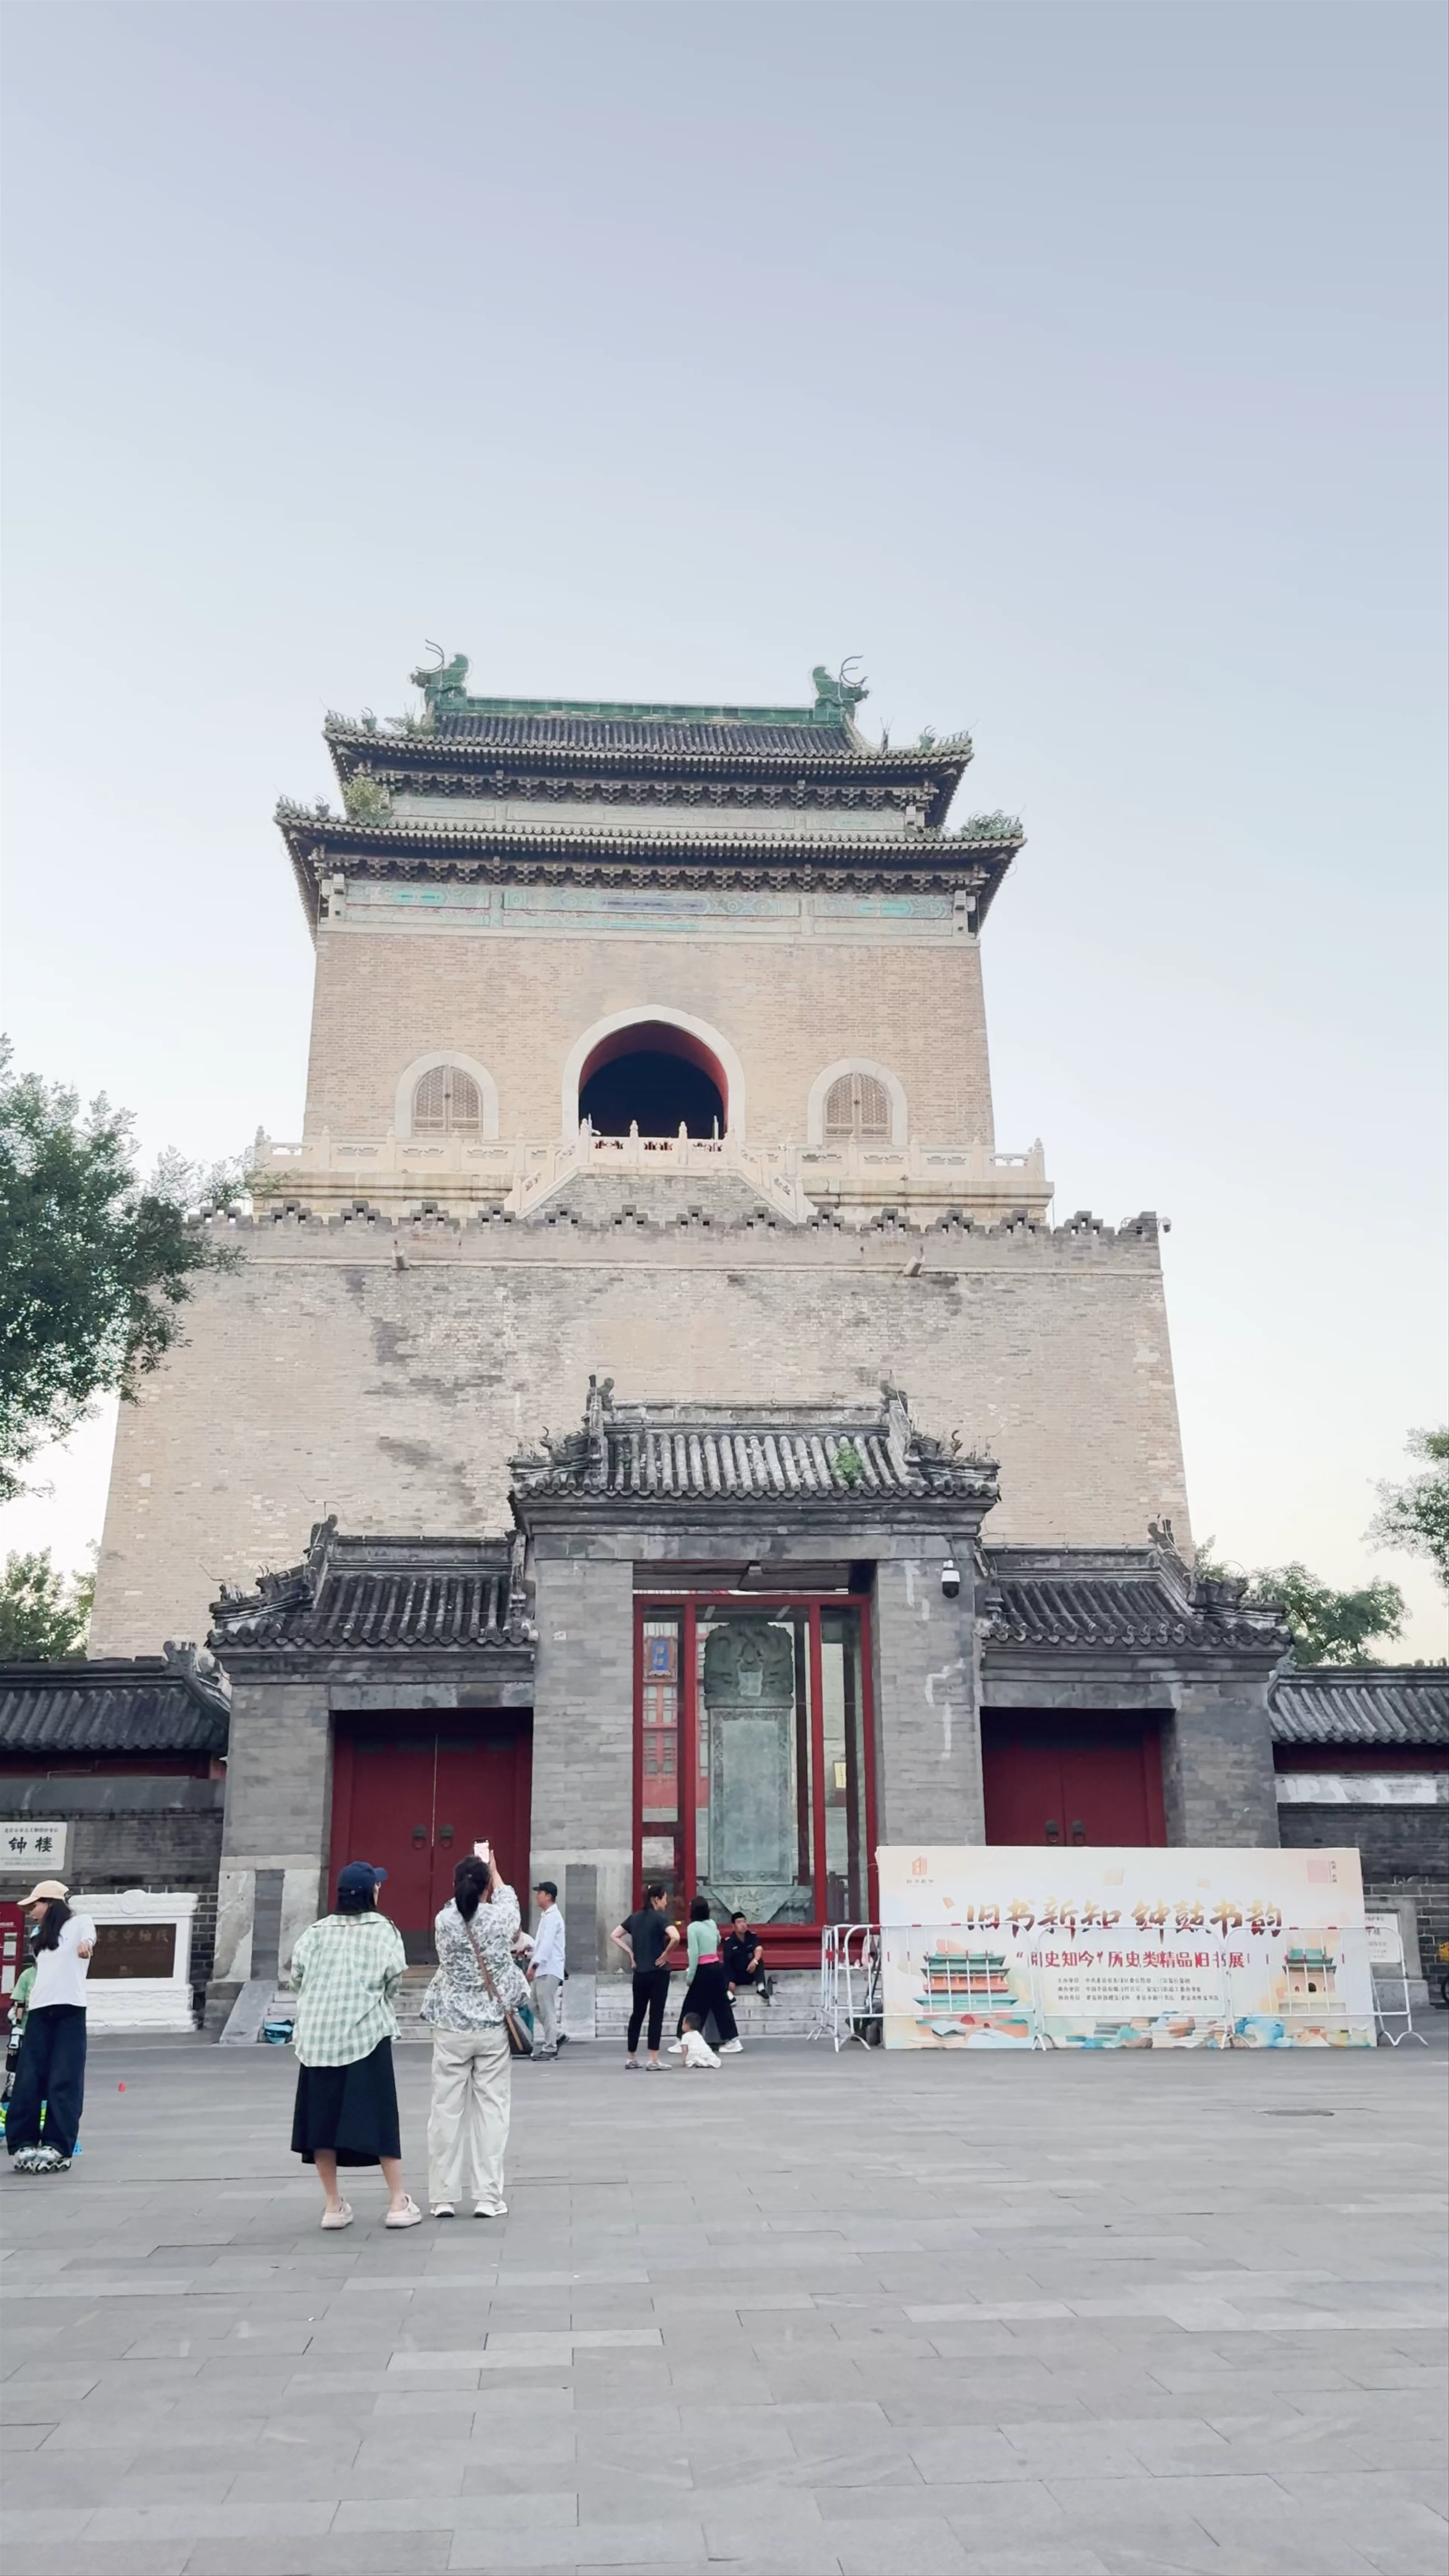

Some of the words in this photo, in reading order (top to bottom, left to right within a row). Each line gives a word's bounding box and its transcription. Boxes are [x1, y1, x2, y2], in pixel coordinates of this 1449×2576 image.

[8, 1836, 53, 1855] 钟楼
[967, 1896, 1122, 1942] 旧书新知
[1130, 1898, 1282, 1944] 钟鼓书韵
